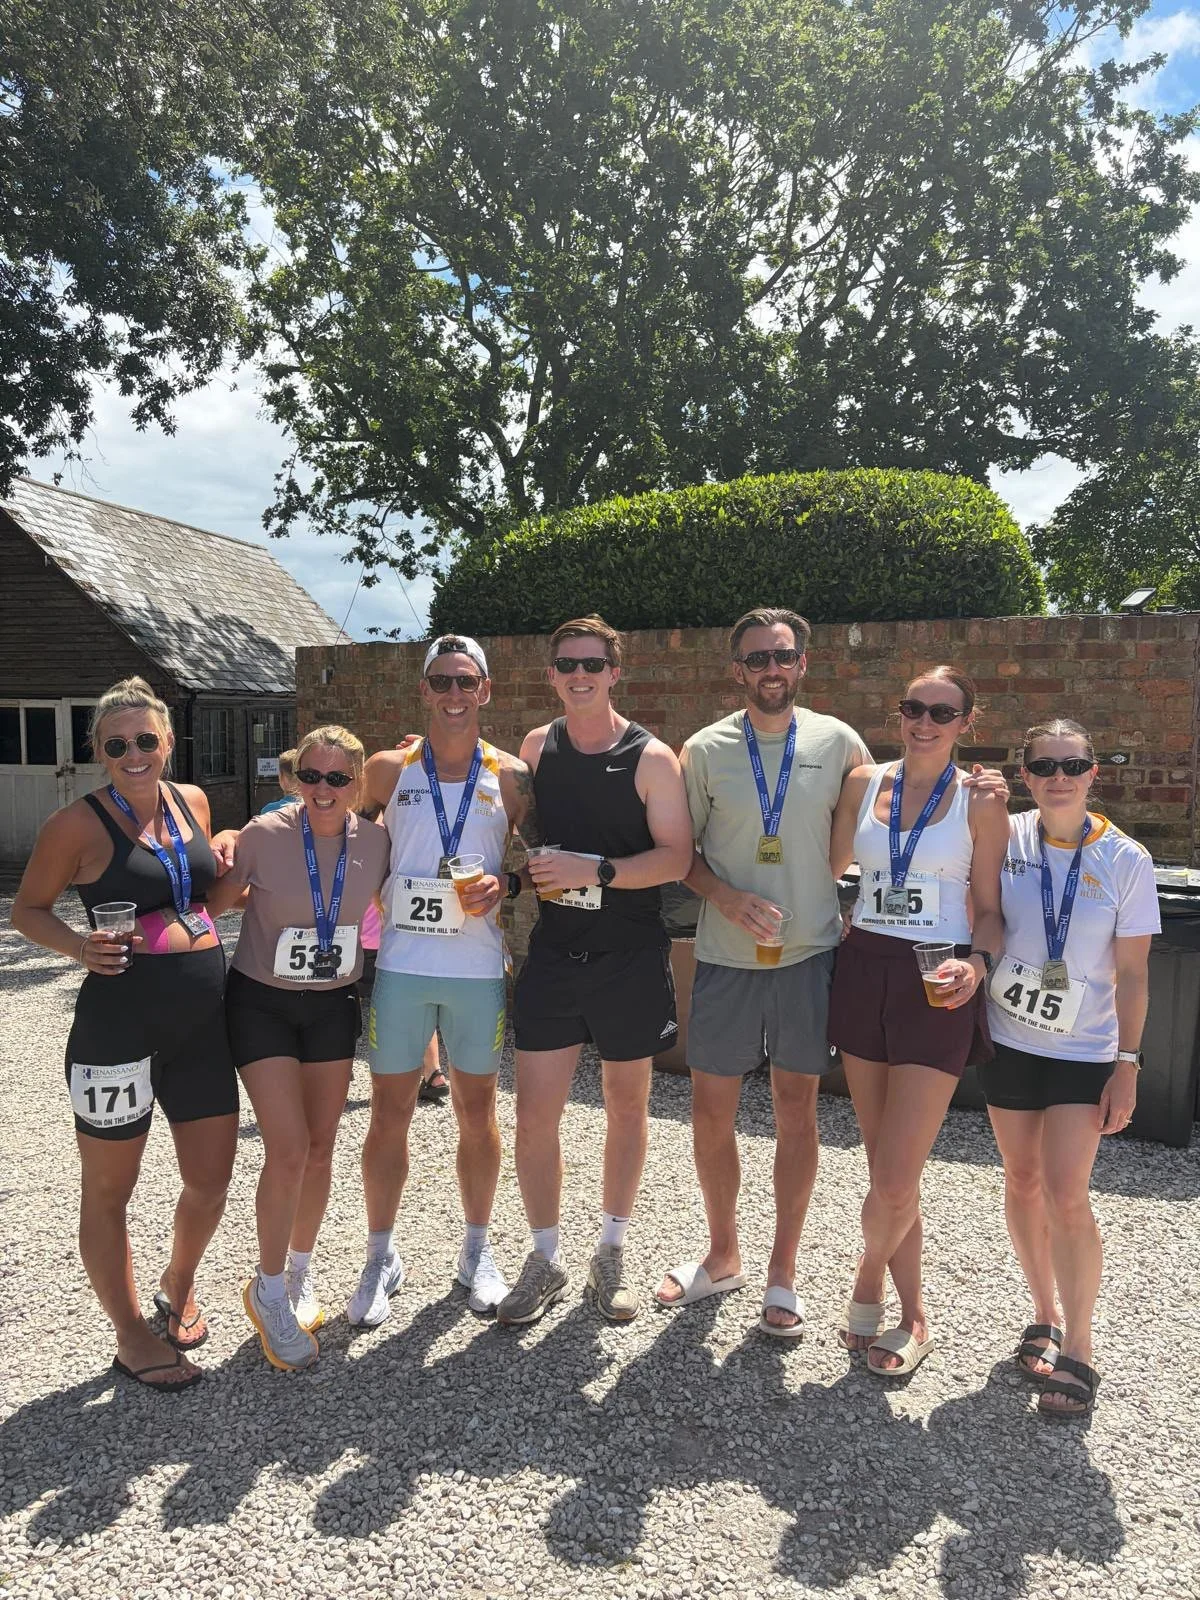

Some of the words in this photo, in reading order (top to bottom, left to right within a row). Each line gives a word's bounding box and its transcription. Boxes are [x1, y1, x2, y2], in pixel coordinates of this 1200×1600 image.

[409, 896, 443, 923] 25
[873, 887, 923, 915] 15
[1003, 982, 1063, 1021] 415
[1018, 1015, 1027, 1023] ON
[1027, 1018, 1038, 1028] THE
[1040, 1023, 1051, 1031] HILL
[84, 1082, 137, 1114] 171
[104, 1118, 113, 1126] ON
[115, 1116, 126, 1125] THE
